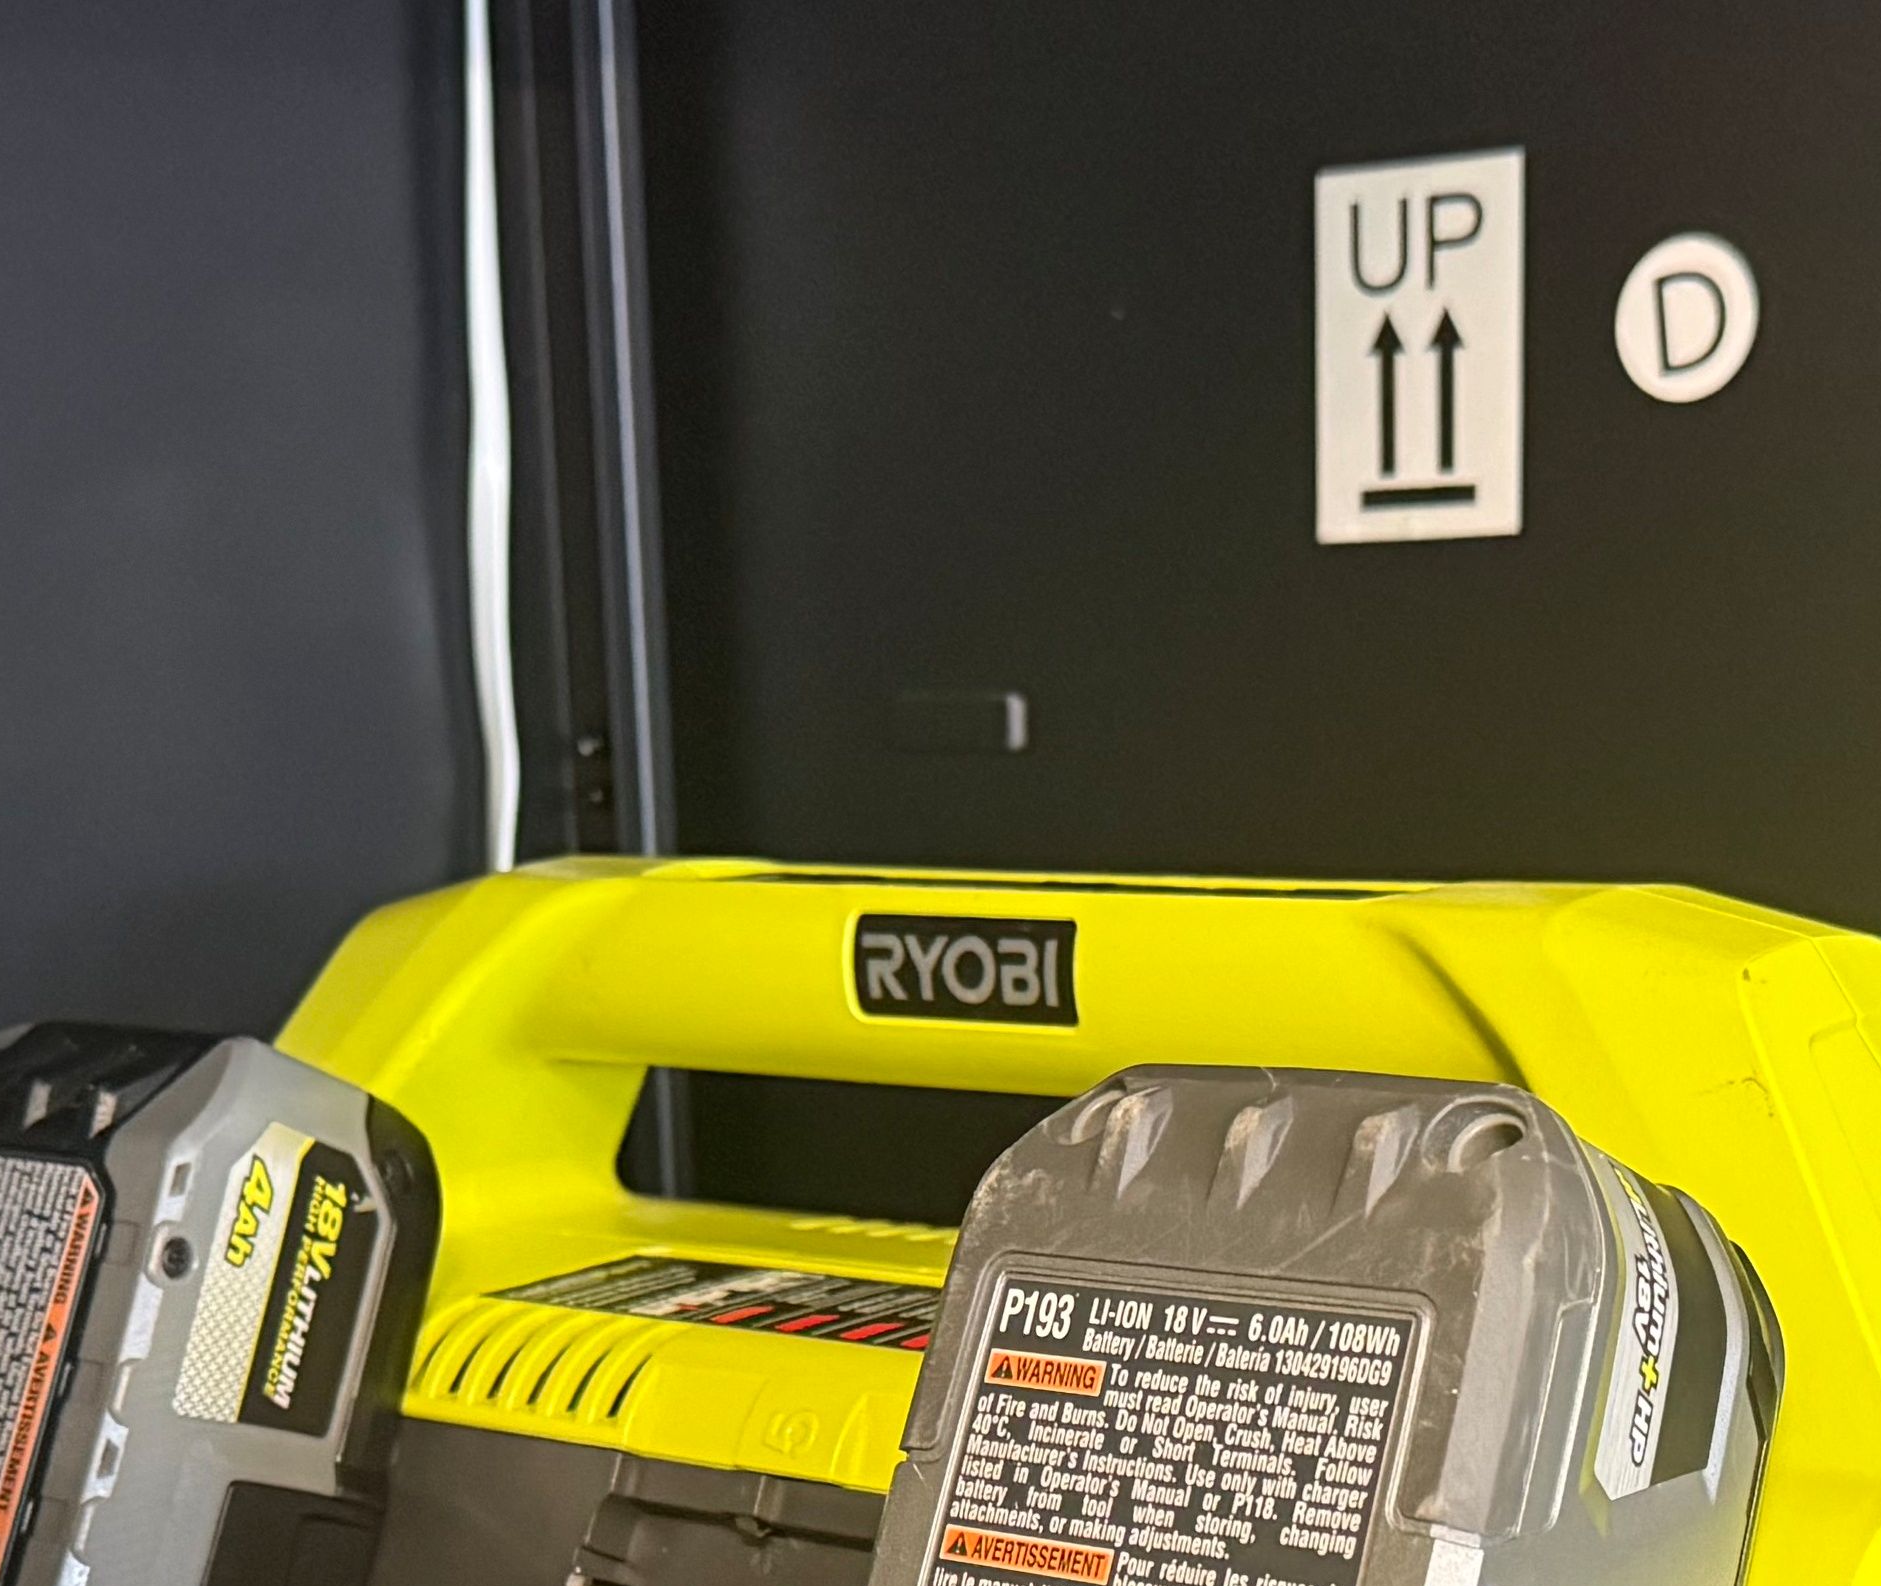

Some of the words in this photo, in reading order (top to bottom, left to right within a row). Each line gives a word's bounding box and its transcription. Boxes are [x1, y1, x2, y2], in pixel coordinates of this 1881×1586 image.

[1349, 192, 1484, 296] UP
[1655, 271, 1726, 378] D
[861, 933, 1059, 1008] RYOBI
[225, 1155, 274, 1267] 4Ah
[304, 1175, 326, 1231] HIGH
[309, 1181, 347, 1280] 18V
[54, 1212, 87, 1304] WARNING
[263, 1235, 311, 1398] PERFORMANCE
[999, 1288, 1075, 1340] P193
[1089, 1298, 1153, 1330] LI-ION
[1248, 1313, 1308, 1346] 6.0Ah
[1330, 1322, 1400, 1356] 108Wh
[1633, 1255, 1653, 1345] 18V
[274, 1267, 323, 1411] LITHIUM
[1016, 1356, 1097, 1389] WARNING
[1083, 1328, 1135, 1361] Battery
[1146, 1335, 1204, 1364] Batterie
[1275, 1349, 1392, 1386] 130429196DG9
[1103, 1390, 1143, 1410] must
[1146, 1394, 1182, 1414] read
[1272, 1406, 1338, 1435] Manual.
[1344, 1415, 1383, 1440] Risk
[1111, 1364, 1128, 1386] To
[1135, 1369, 1188, 1393] reduce
[1195, 1375, 1220, 1397] the
[1227, 1378, 1259, 1402] risk
[1265, 1383, 1283, 1404] of
[1286, 1385, 1339, 1416] injury,
[1350, 1397, 1388, 1417] user
[978, 1393, 994, 1412] of
[996, 1394, 1026, 1417] Fire
[1030, 1401, 1059, 1421] and
[1061, 1402, 1108, 1428] Burns.
[1115, 1409, 1137, 1432] Do
[1141, 1412, 1169, 1437] Not
[1173, 1416, 1217, 1447] Open,
[1222, 1423, 1274, 1453] Crush,
[1282, 1431, 1321, 1456] Heat
[1324, 1436, 1376, 1463] Above
[1028, 1420, 1104, 1450] Incinerate
[1120, 1436, 1138, 1454] or
[1152, 1436, 1195, 1462] Short
[1212, 1444, 1295, 1476] Terminals.
[1315, 1458, 1372, 1486] Follow
[1631, 1391, 1653, 1467] HP
[961, 1455, 1004, 1480] listed
[1014, 1462, 1029, 1483] in
[1131, 1478, 1191, 1507] Manual
[1203, 1493, 1221, 1511] or
[1232, 1493, 1277, 1520] P118.
[1292, 1501, 1361, 1532] Remove
[1083, 1450, 1177, 1482] Instructions.
[1185, 1463, 1215, 1488] Use
[1221, 1471, 1257, 1498] only
[1262, 1476, 1297, 1499] with
[1300, 1480, 1368, 1510] charger
[950, 1499, 1043, 1533] attachments,
[1050, 1516, 1067, 1534] or
[1069, 1518, 1126, 1547] making
[1129, 1526, 1229, 1559] adjustments.
[956, 1475, 1008, 1506] battery
[1026, 1486, 1062, 1511] from
[1082, 1494, 1113, 1518] tool
[1133, 1503, 1174, 1527] when
[1195, 1512, 1255, 1543] storing,
[1280, 1524, 1356, 1559] changing
[971, 1534, 1106, 1578] AVERTISSEMENT
[1117, 1552, 1154, 1577] Pour
